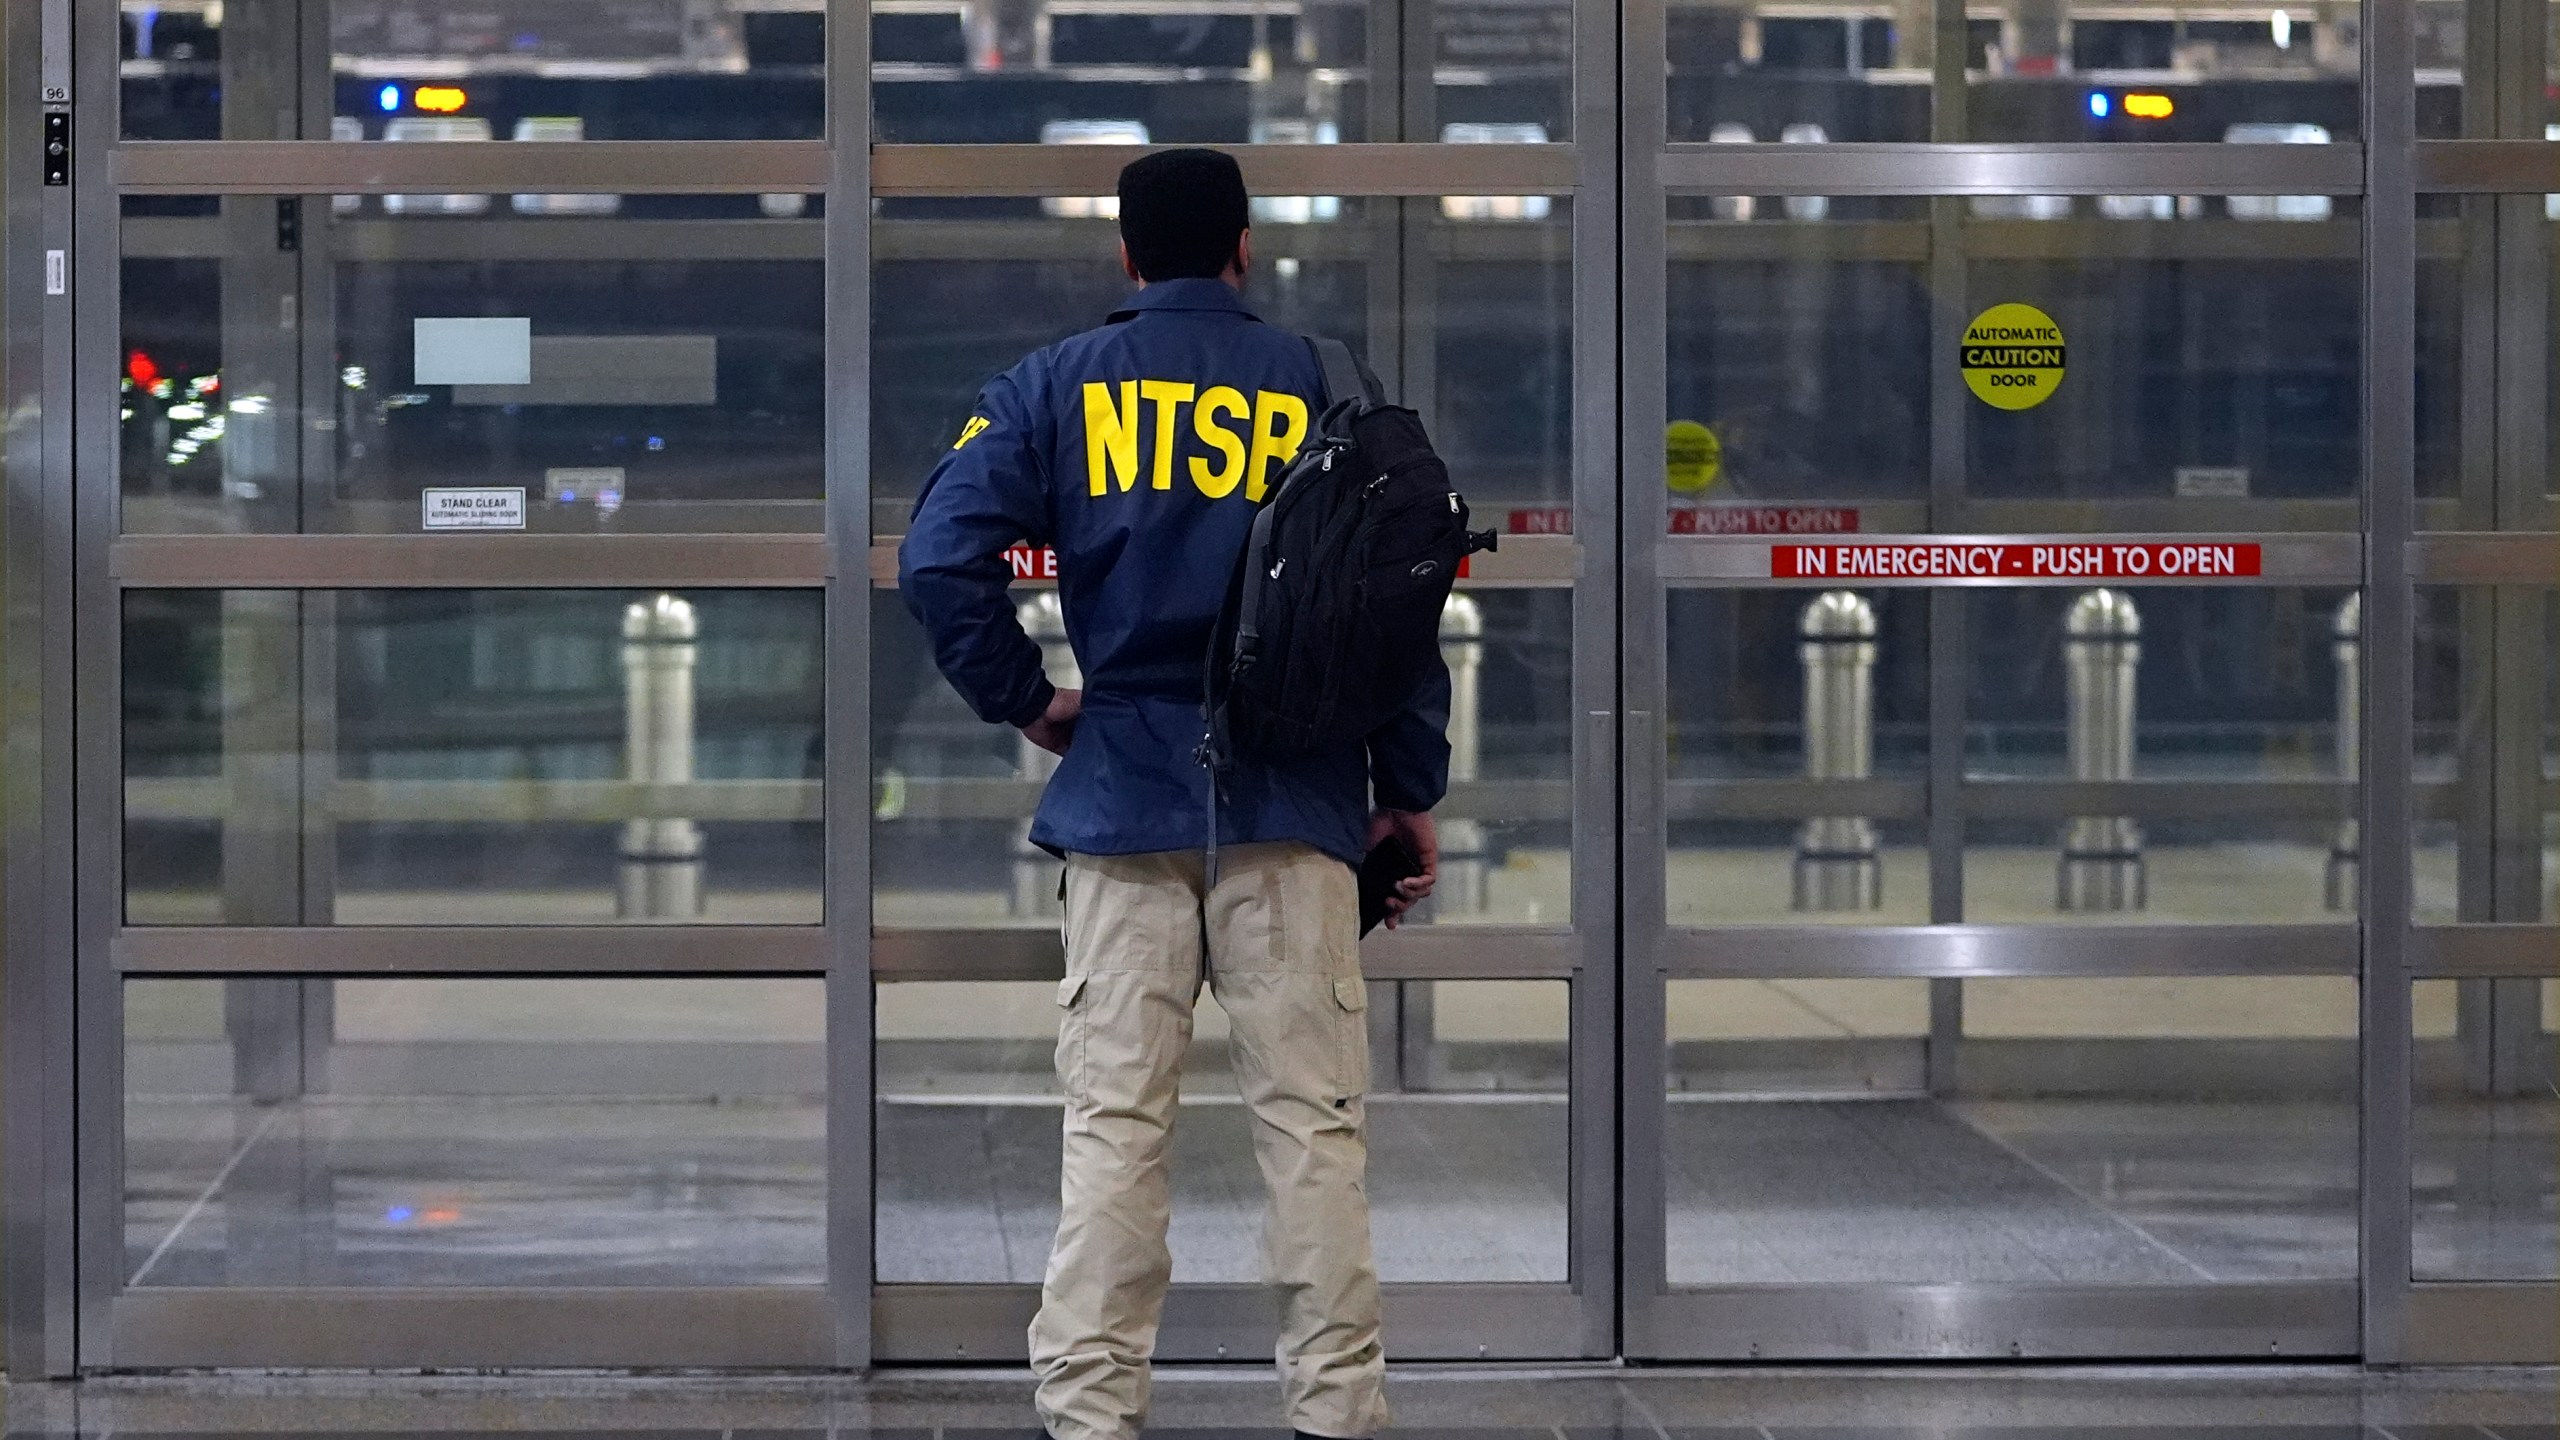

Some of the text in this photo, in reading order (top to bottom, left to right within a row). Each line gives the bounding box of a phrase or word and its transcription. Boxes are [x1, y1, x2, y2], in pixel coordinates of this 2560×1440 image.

[46, 87, 65, 100] 96
[1968, 327, 2057, 341] AUTOMATIC
[1966, 349, 2061, 366] CAUTION
[1991, 374, 2037, 387] DOOR
[1082, 379, 1309, 503] NTSB
[441, 498, 507, 508] STAND CLEAR
[1796, 548, 1826, 575] IN
[1836, 547, 2004, 575] EMERGENCY
[2032, 547, 2103, 574] PUSH
[2112, 547, 2150, 574] TO
[2158, 547, 2235, 574] OPEN
